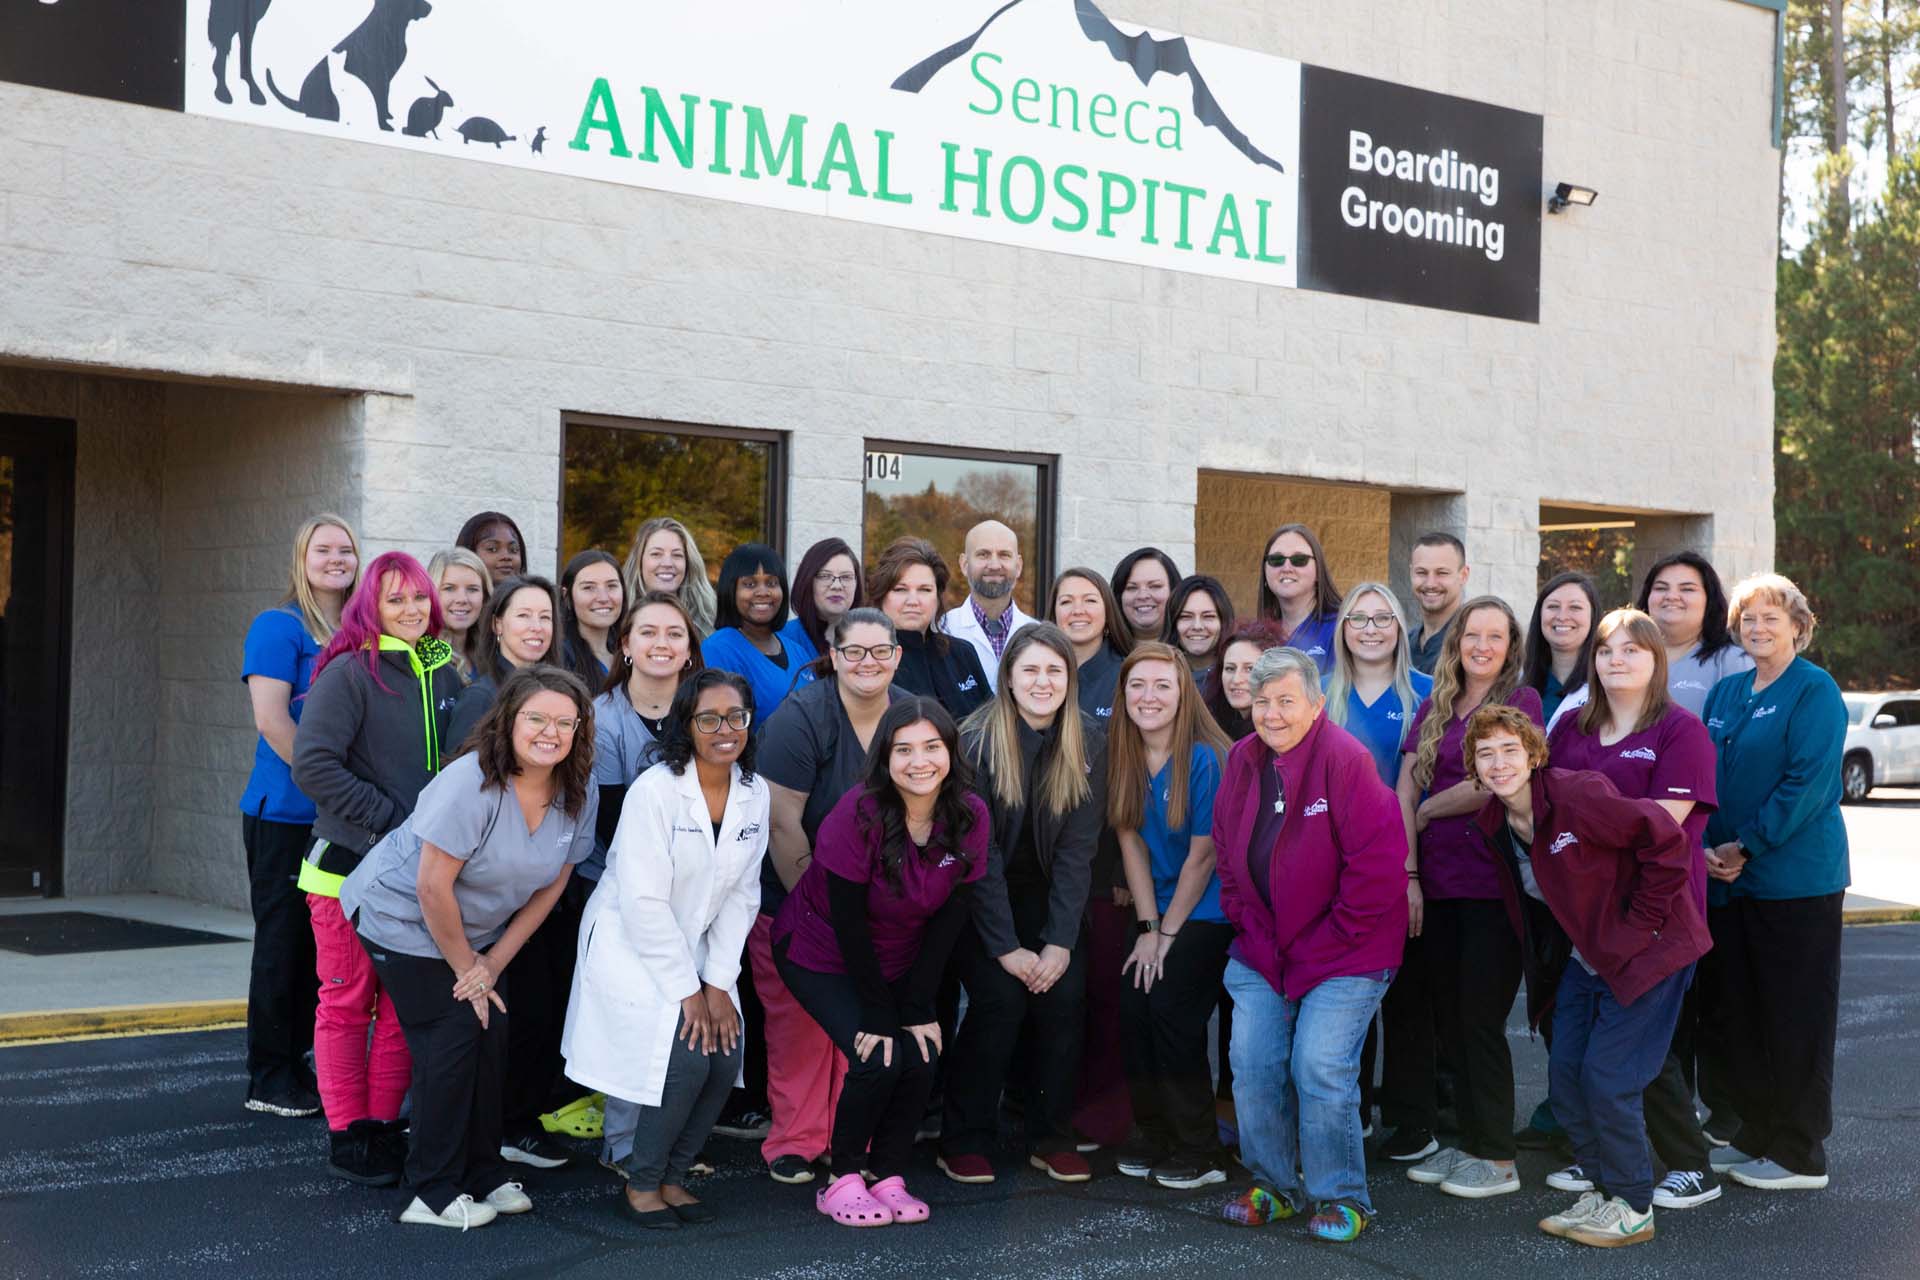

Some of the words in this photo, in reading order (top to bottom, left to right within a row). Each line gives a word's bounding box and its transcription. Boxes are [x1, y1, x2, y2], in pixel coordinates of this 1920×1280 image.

[968, 51, 1182, 151] Seneca
[567, 76, 913, 205] ANIMAL
[938, 142, 1286, 265] HOSPITAL
[1348, 129, 1499, 207] Boarding
[1340, 185, 1505, 262] Grooming
[865, 454, 900, 479] 104
